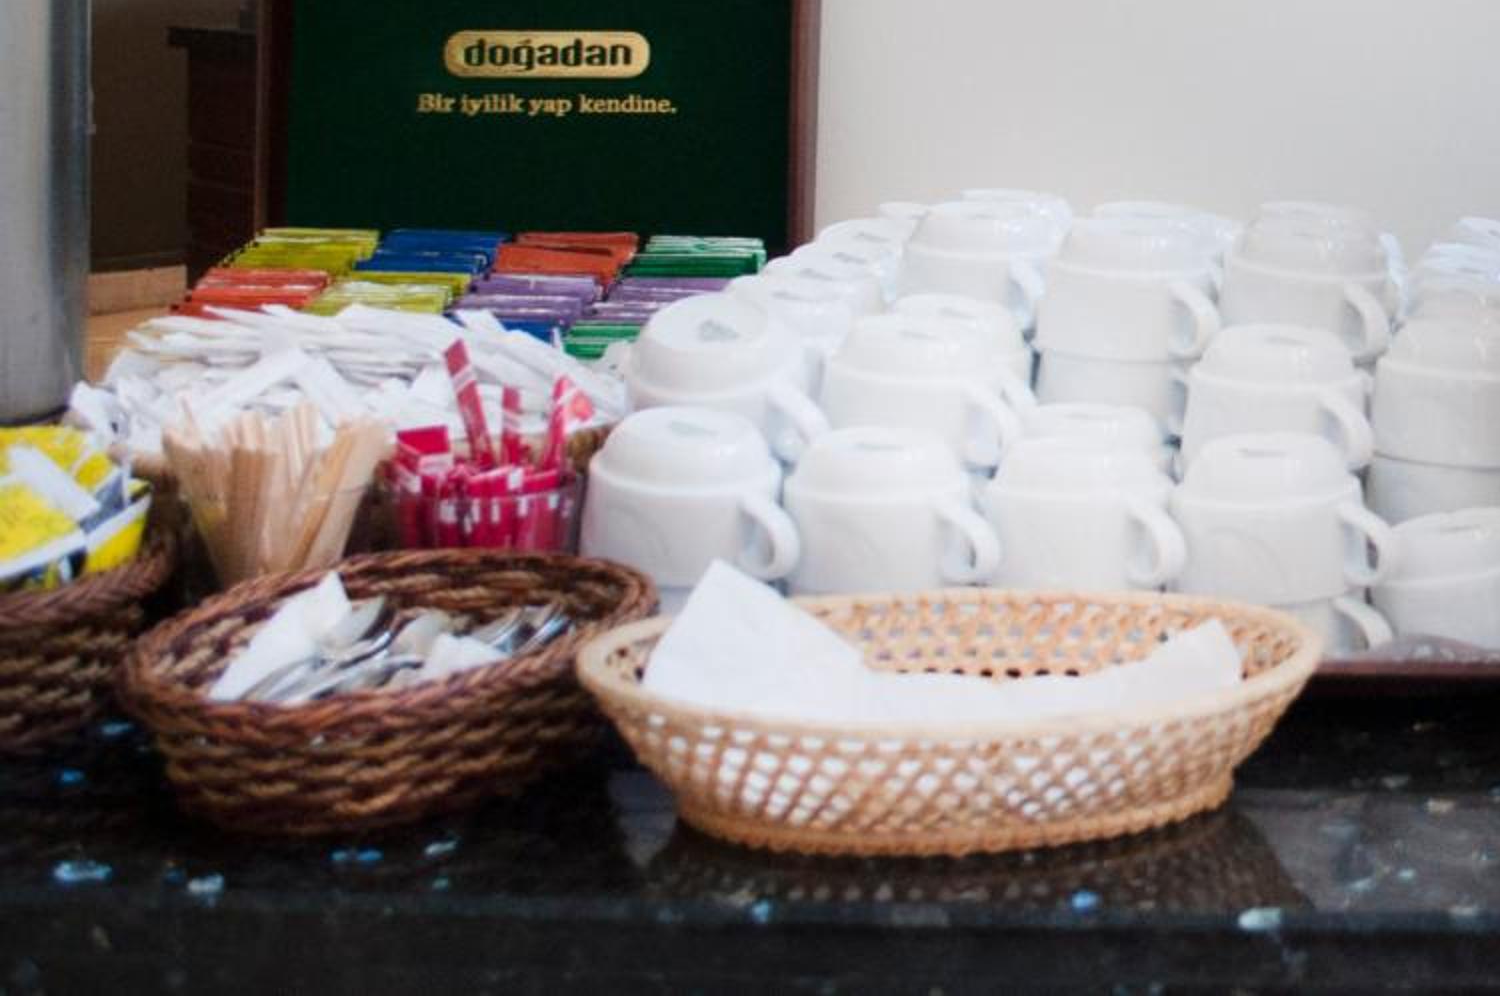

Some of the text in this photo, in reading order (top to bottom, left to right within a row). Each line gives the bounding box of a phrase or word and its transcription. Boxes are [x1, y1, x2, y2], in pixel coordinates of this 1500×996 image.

[416, 92, 679, 117] Bir iyilik yap kendine.
